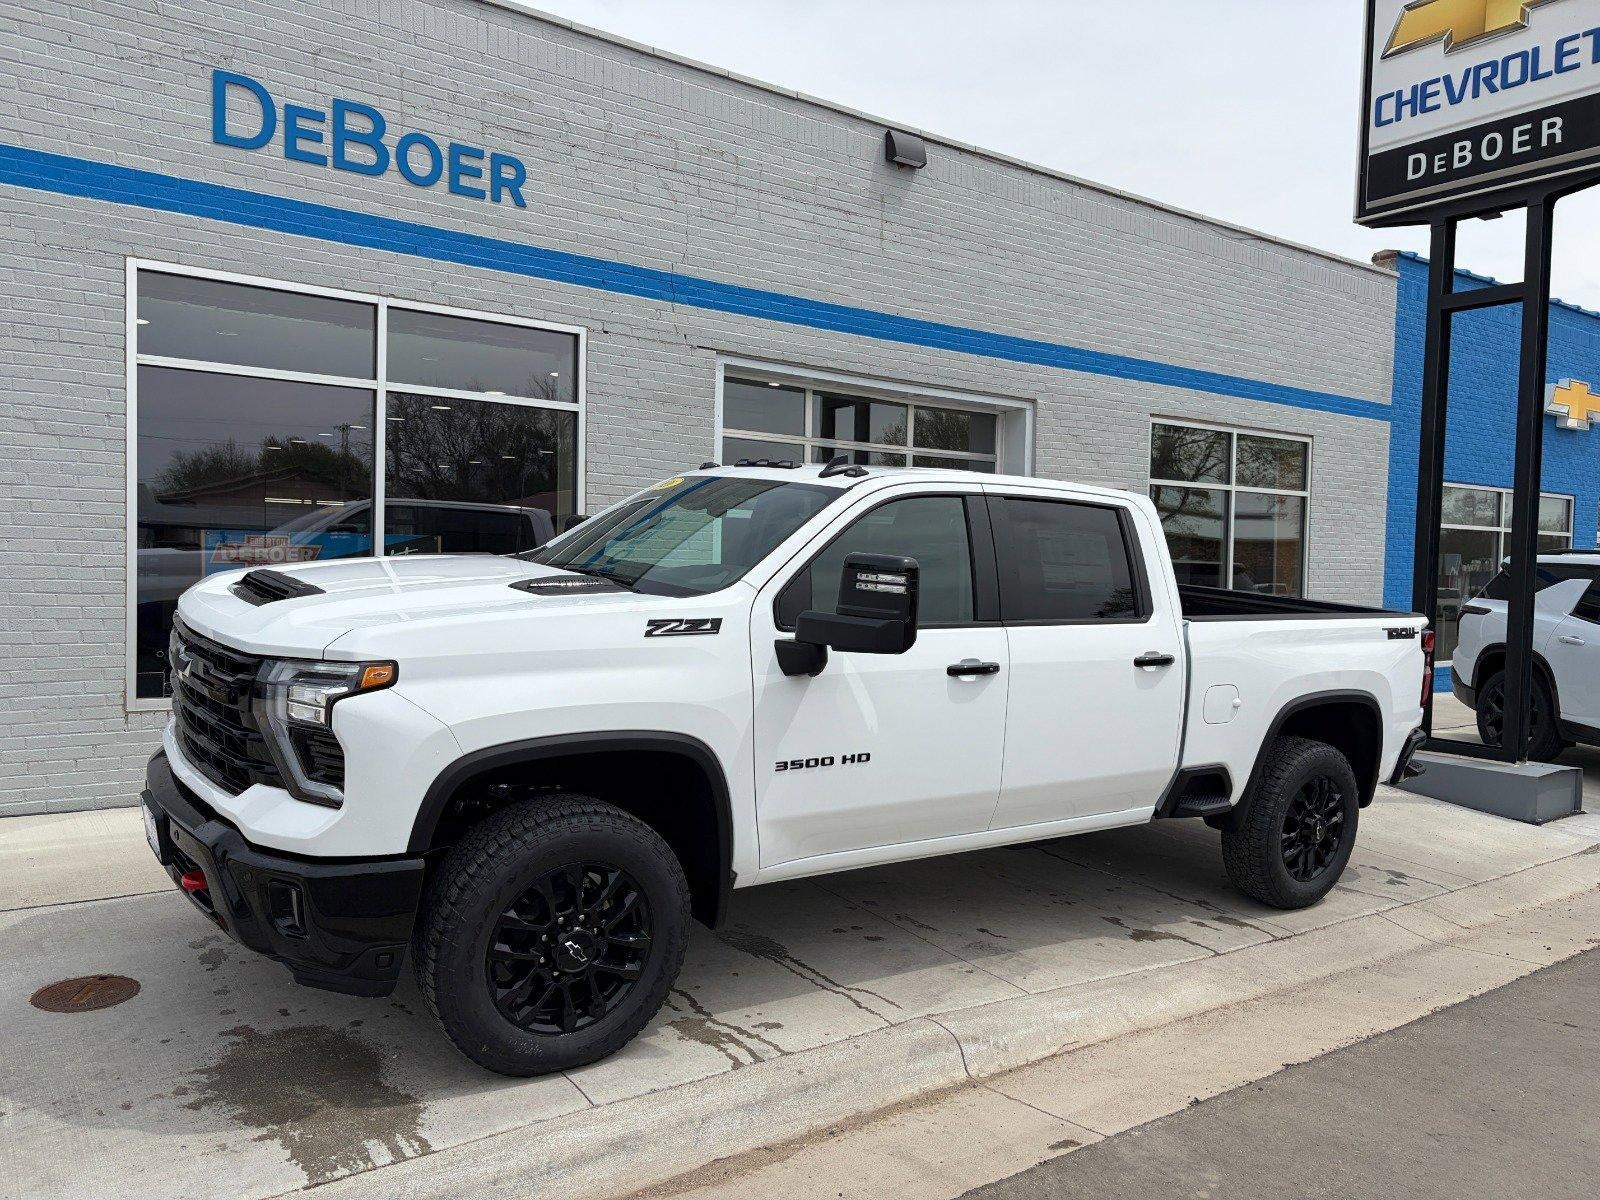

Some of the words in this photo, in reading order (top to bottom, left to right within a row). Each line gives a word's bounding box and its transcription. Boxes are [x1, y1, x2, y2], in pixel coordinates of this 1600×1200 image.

[1374, 27, 1600, 128] CHEVROLET
[213, 69, 528, 208] DEBOER
[1406, 116, 1564, 181] DEBOER
[221, 546, 314, 562] DEBOER
[644, 617, 723, 638] Z71
[774, 756, 835, 772] 3500
[841, 752, 871, 765] HD
